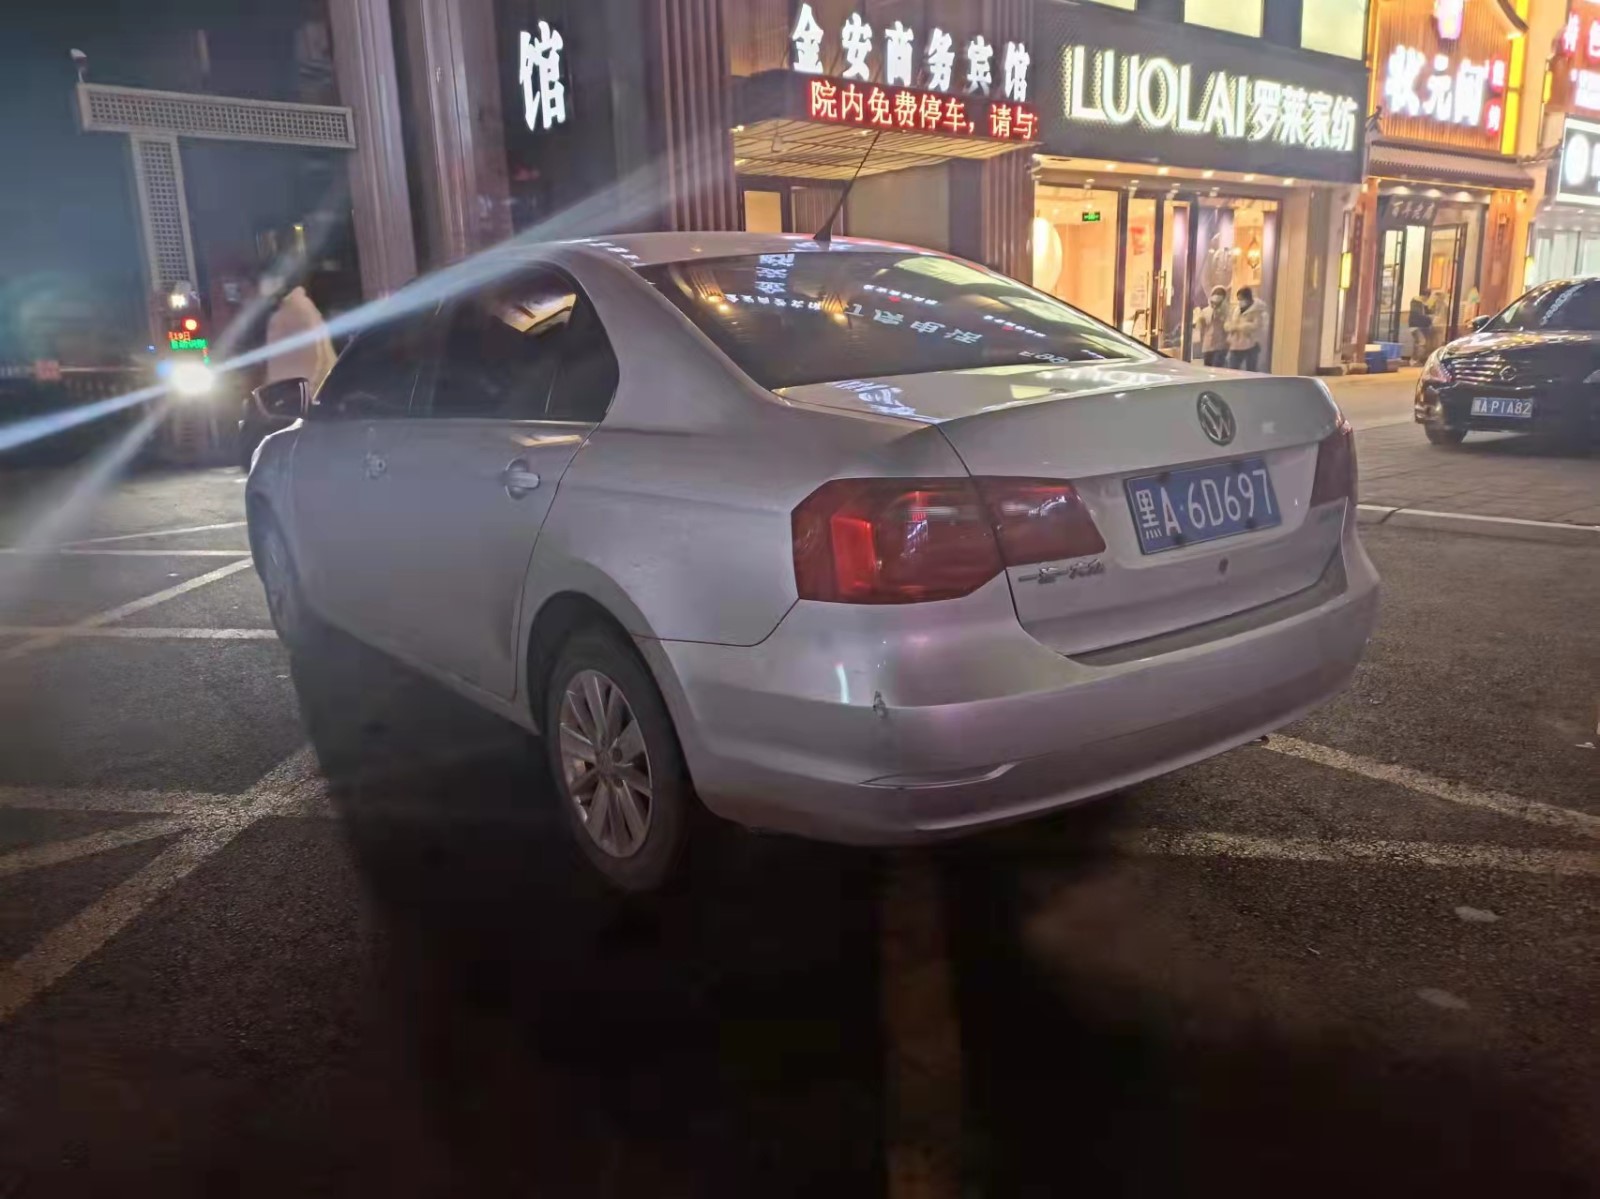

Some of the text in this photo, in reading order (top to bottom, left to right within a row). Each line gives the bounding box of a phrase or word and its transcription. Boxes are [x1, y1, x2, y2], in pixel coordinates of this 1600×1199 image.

[519, 20, 567, 131] 馆
[792, 3, 1031, 102] 金安商务宾馆
[1066, 45, 1358, 151] LUOLAI 罗莱家纺
